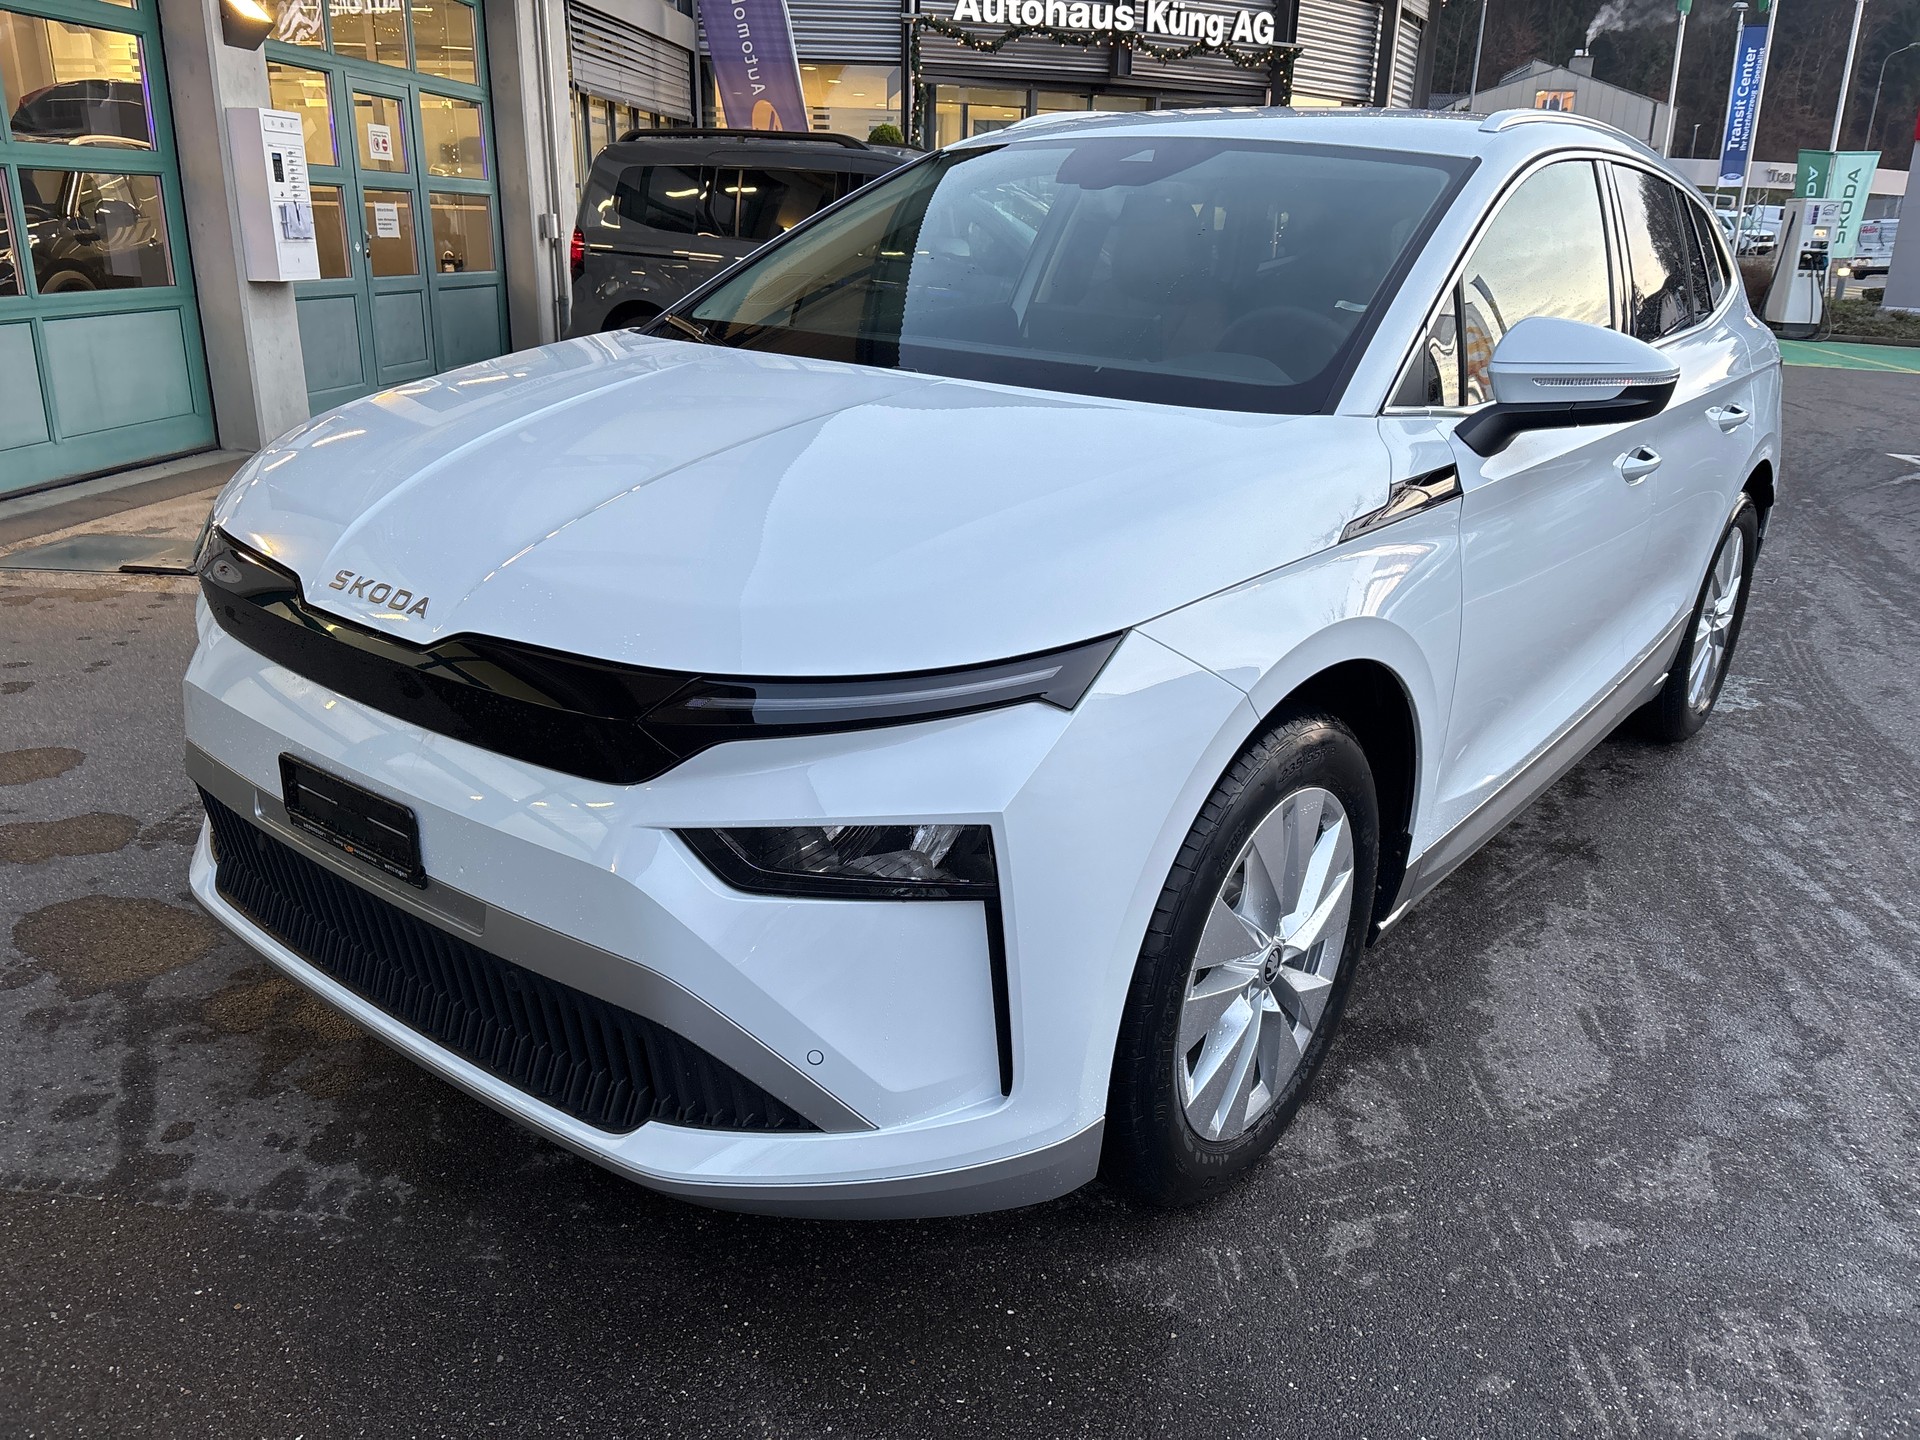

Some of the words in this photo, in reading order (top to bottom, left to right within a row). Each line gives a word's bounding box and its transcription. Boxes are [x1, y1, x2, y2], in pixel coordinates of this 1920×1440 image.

[952, 0, 1136, 31] Autohaus
[1147, 0, 1225, 46] Küng
[1232, 10, 1276, 45] AG
[1726, 99, 1746, 151] Transit
[1737, 46, 1757, 97] Center
